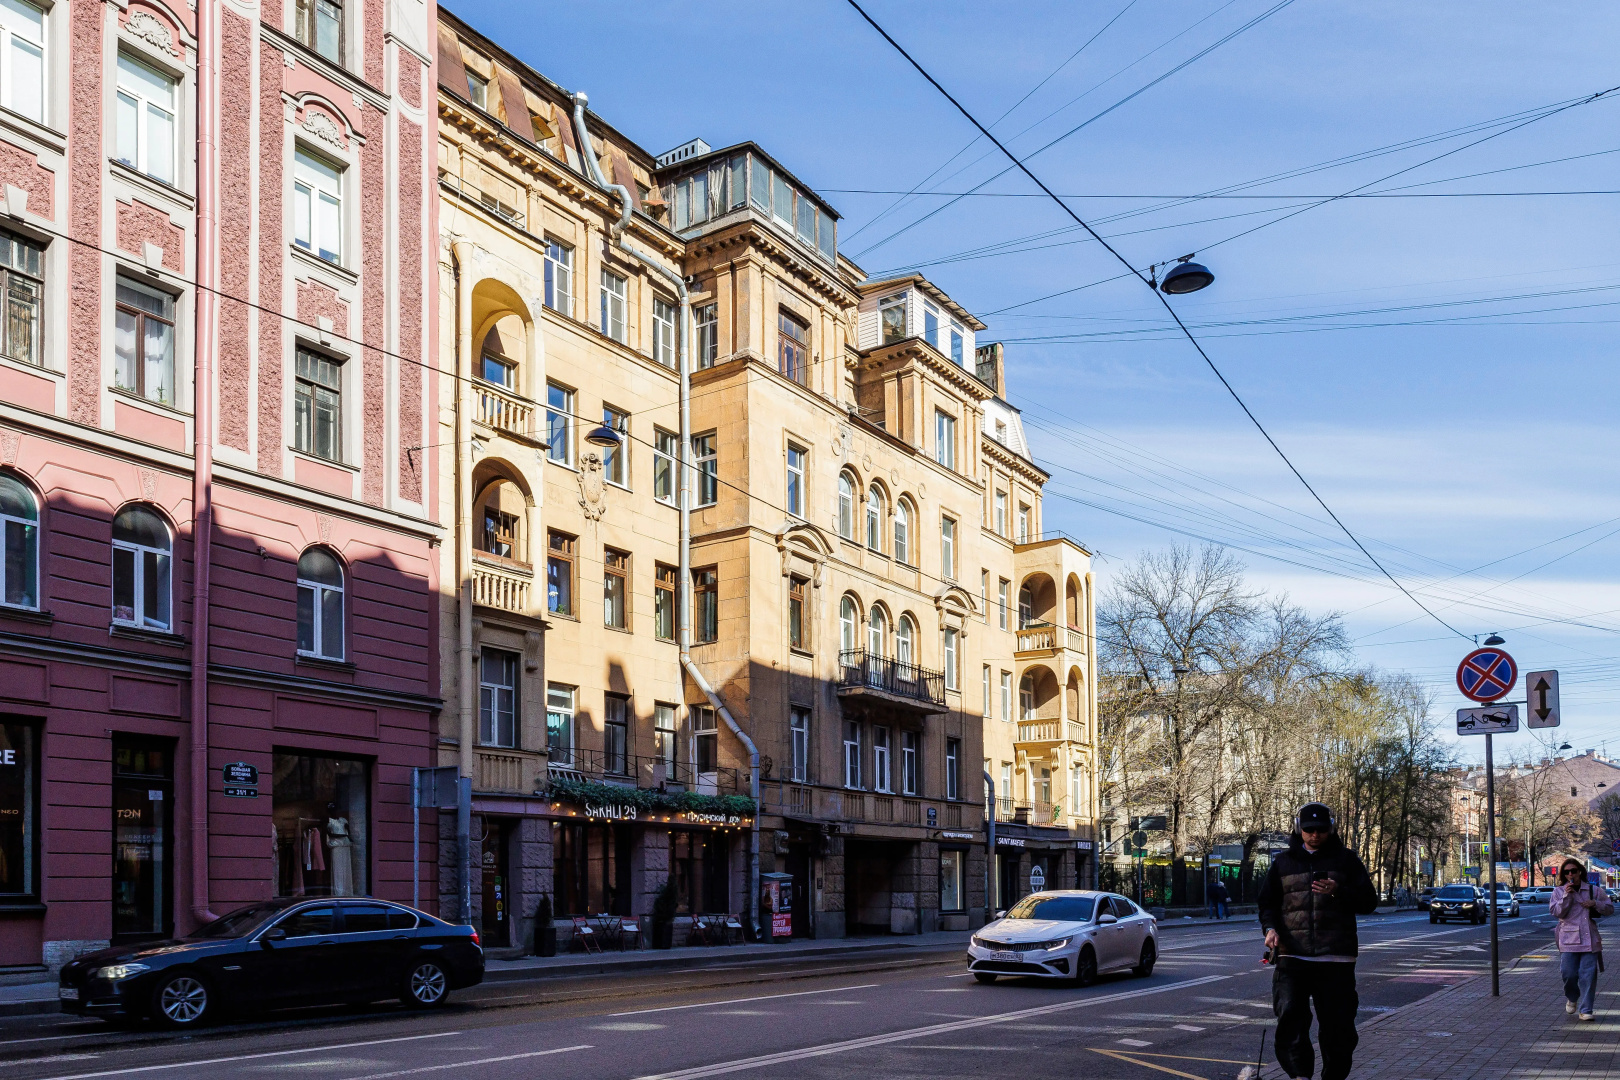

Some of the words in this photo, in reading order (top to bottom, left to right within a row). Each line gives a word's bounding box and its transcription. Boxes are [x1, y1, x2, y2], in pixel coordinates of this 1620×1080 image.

[0, 749, 16, 765] E
[585, 803, 621, 819] SAKHLI
[624, 806, 637, 820] 29
